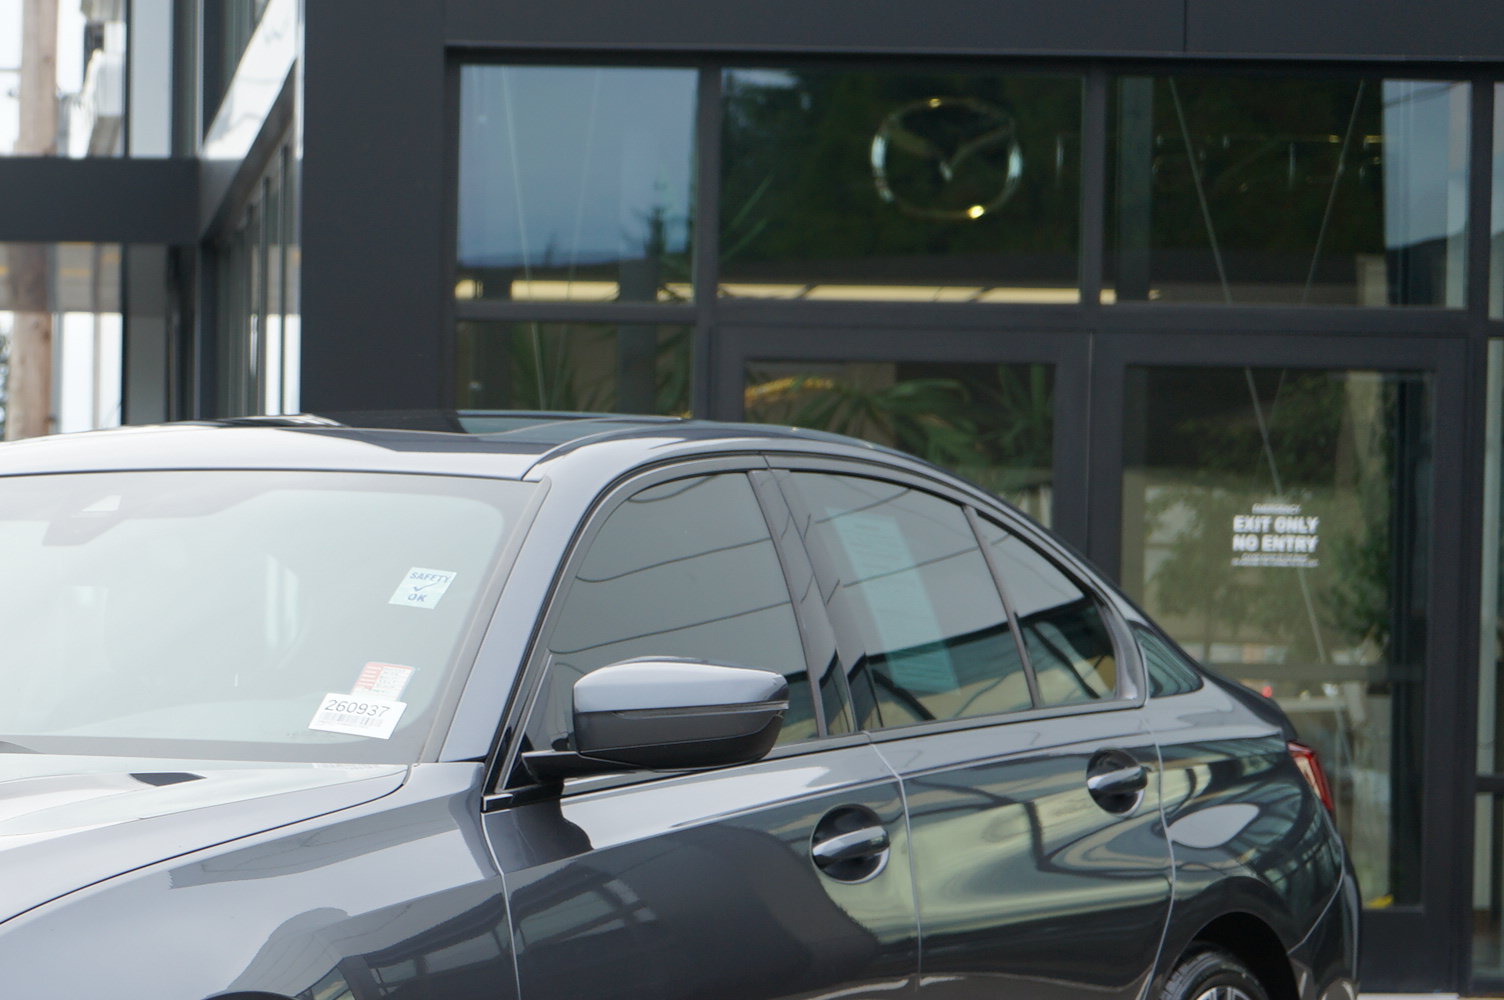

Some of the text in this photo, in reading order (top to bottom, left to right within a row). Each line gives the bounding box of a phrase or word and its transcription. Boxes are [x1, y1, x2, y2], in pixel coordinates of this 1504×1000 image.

[1233, 515, 1319, 533] EXIT ONLY
[1232, 534, 1318, 552] NO ENTRY
[409, 571, 450, 583] SAFETY
[408, 593, 427, 602] OK
[324, 700, 390, 718] 260937
